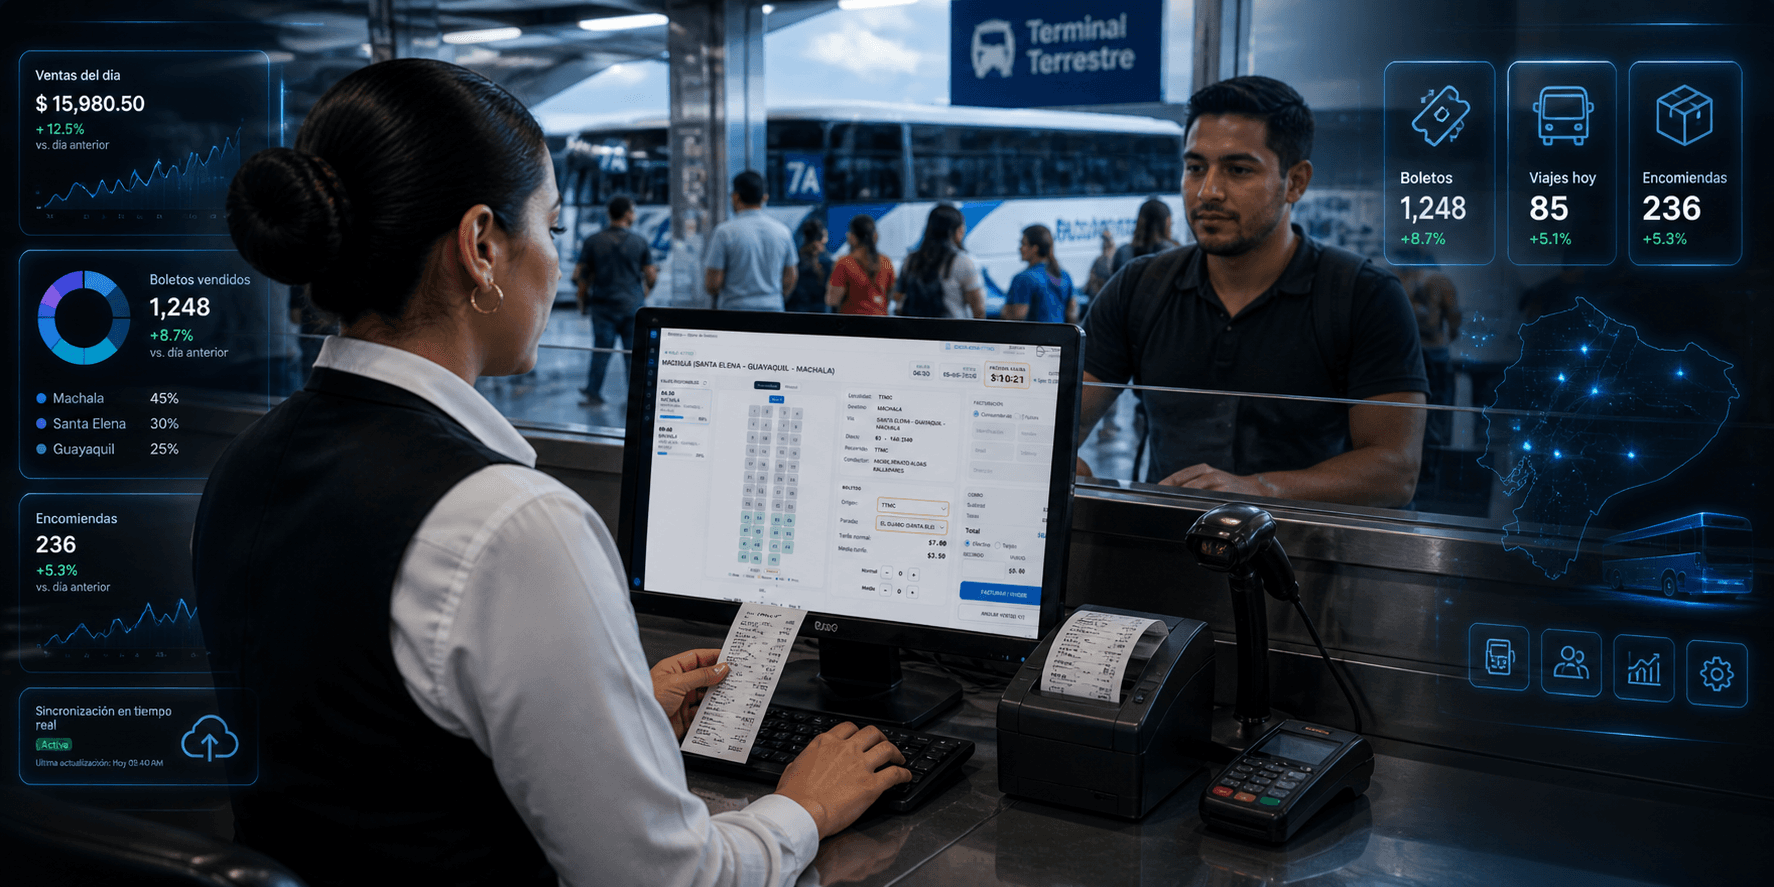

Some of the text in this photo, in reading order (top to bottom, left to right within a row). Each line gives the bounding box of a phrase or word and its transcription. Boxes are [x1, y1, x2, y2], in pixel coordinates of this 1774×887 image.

[1026, 12, 1128, 44] Terminal
[1026, 46, 1136, 75] Terrestre
[786, 161, 820, 194] 7A
[748, 363, 790, 372] GUAYAQUIL
[796, 366, 835, 376] MACHALA)
